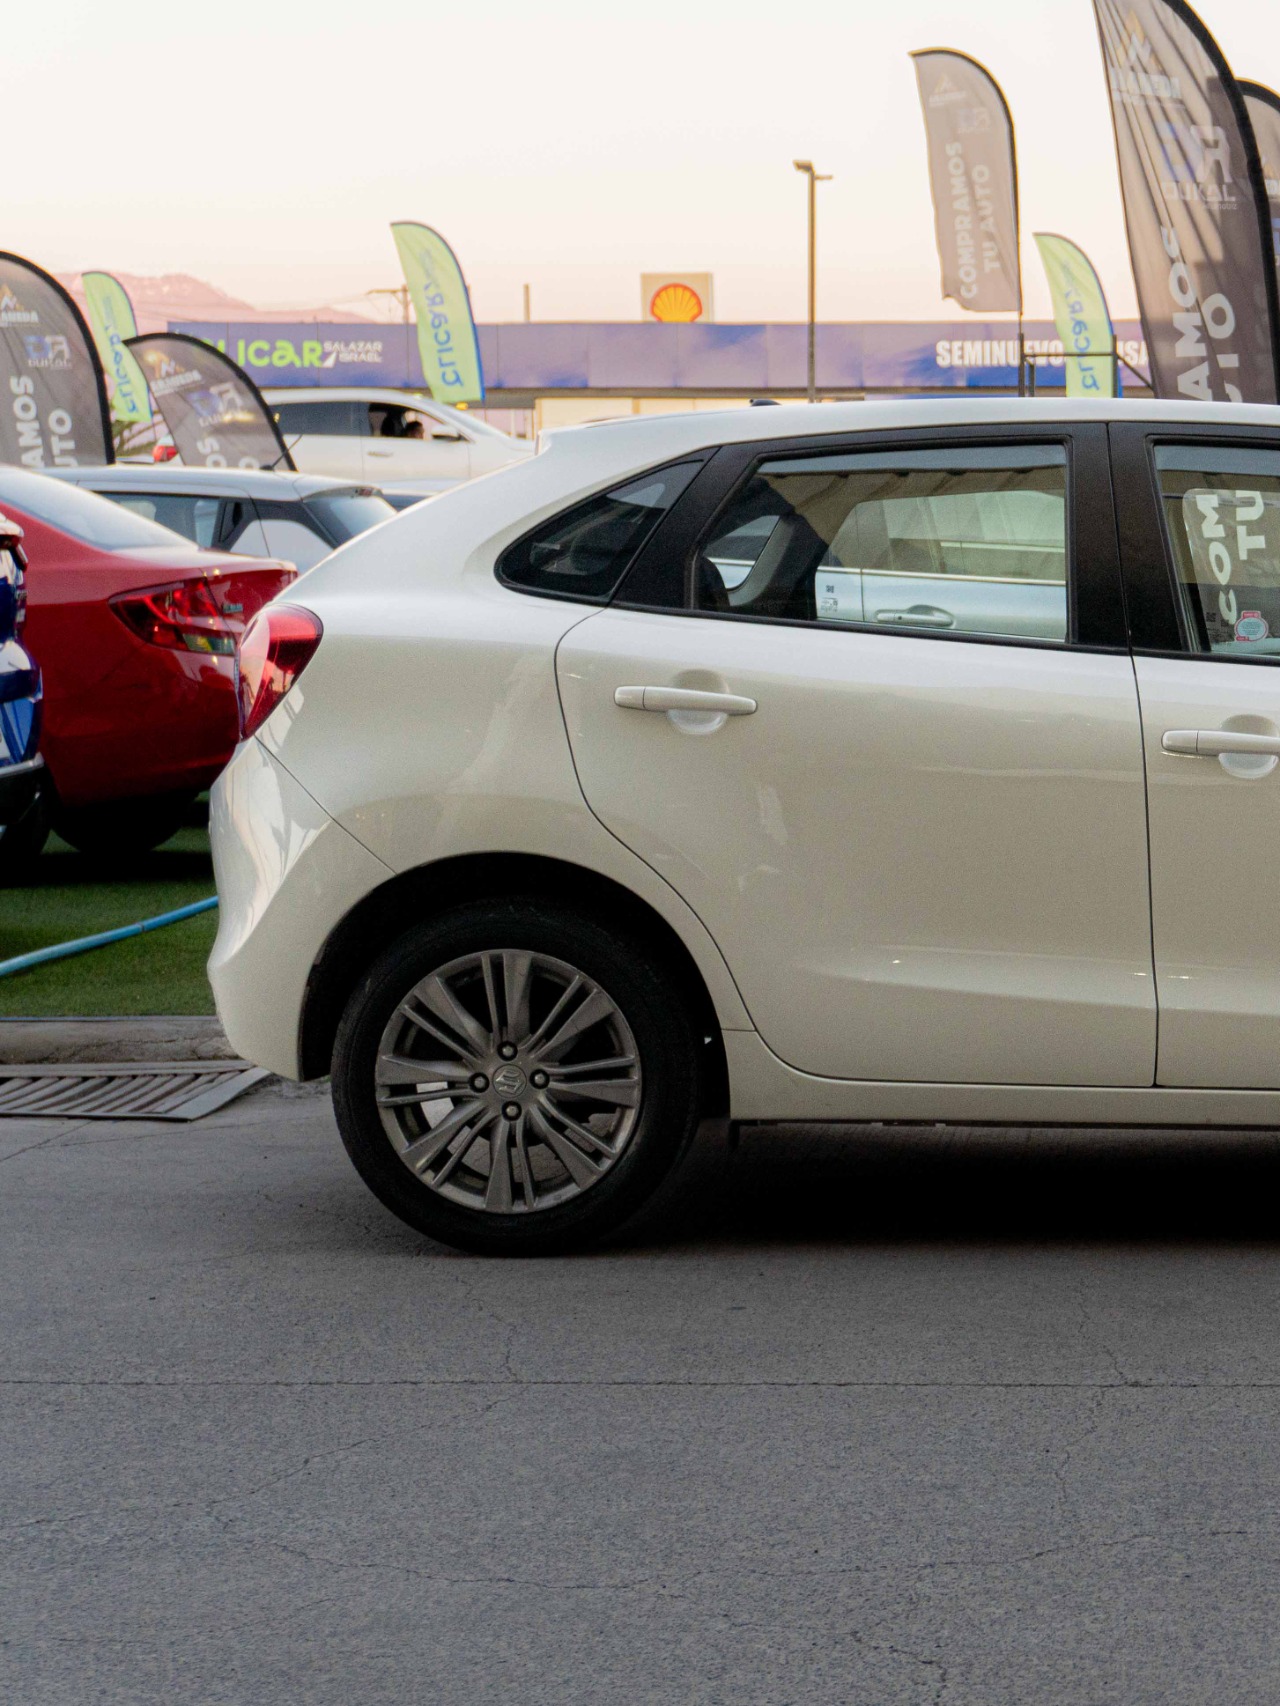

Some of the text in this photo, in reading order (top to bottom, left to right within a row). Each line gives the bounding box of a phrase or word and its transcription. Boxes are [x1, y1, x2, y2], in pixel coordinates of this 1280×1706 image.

[945, 140, 978, 299] COMPRAMOS
[971, 163, 1000, 274] TU AUTO
[323, 340, 383, 352] SALAZAR
[339, 351, 383, 364] ISRAEL
[936, 339, 1066, 368] SEMINUEVO
